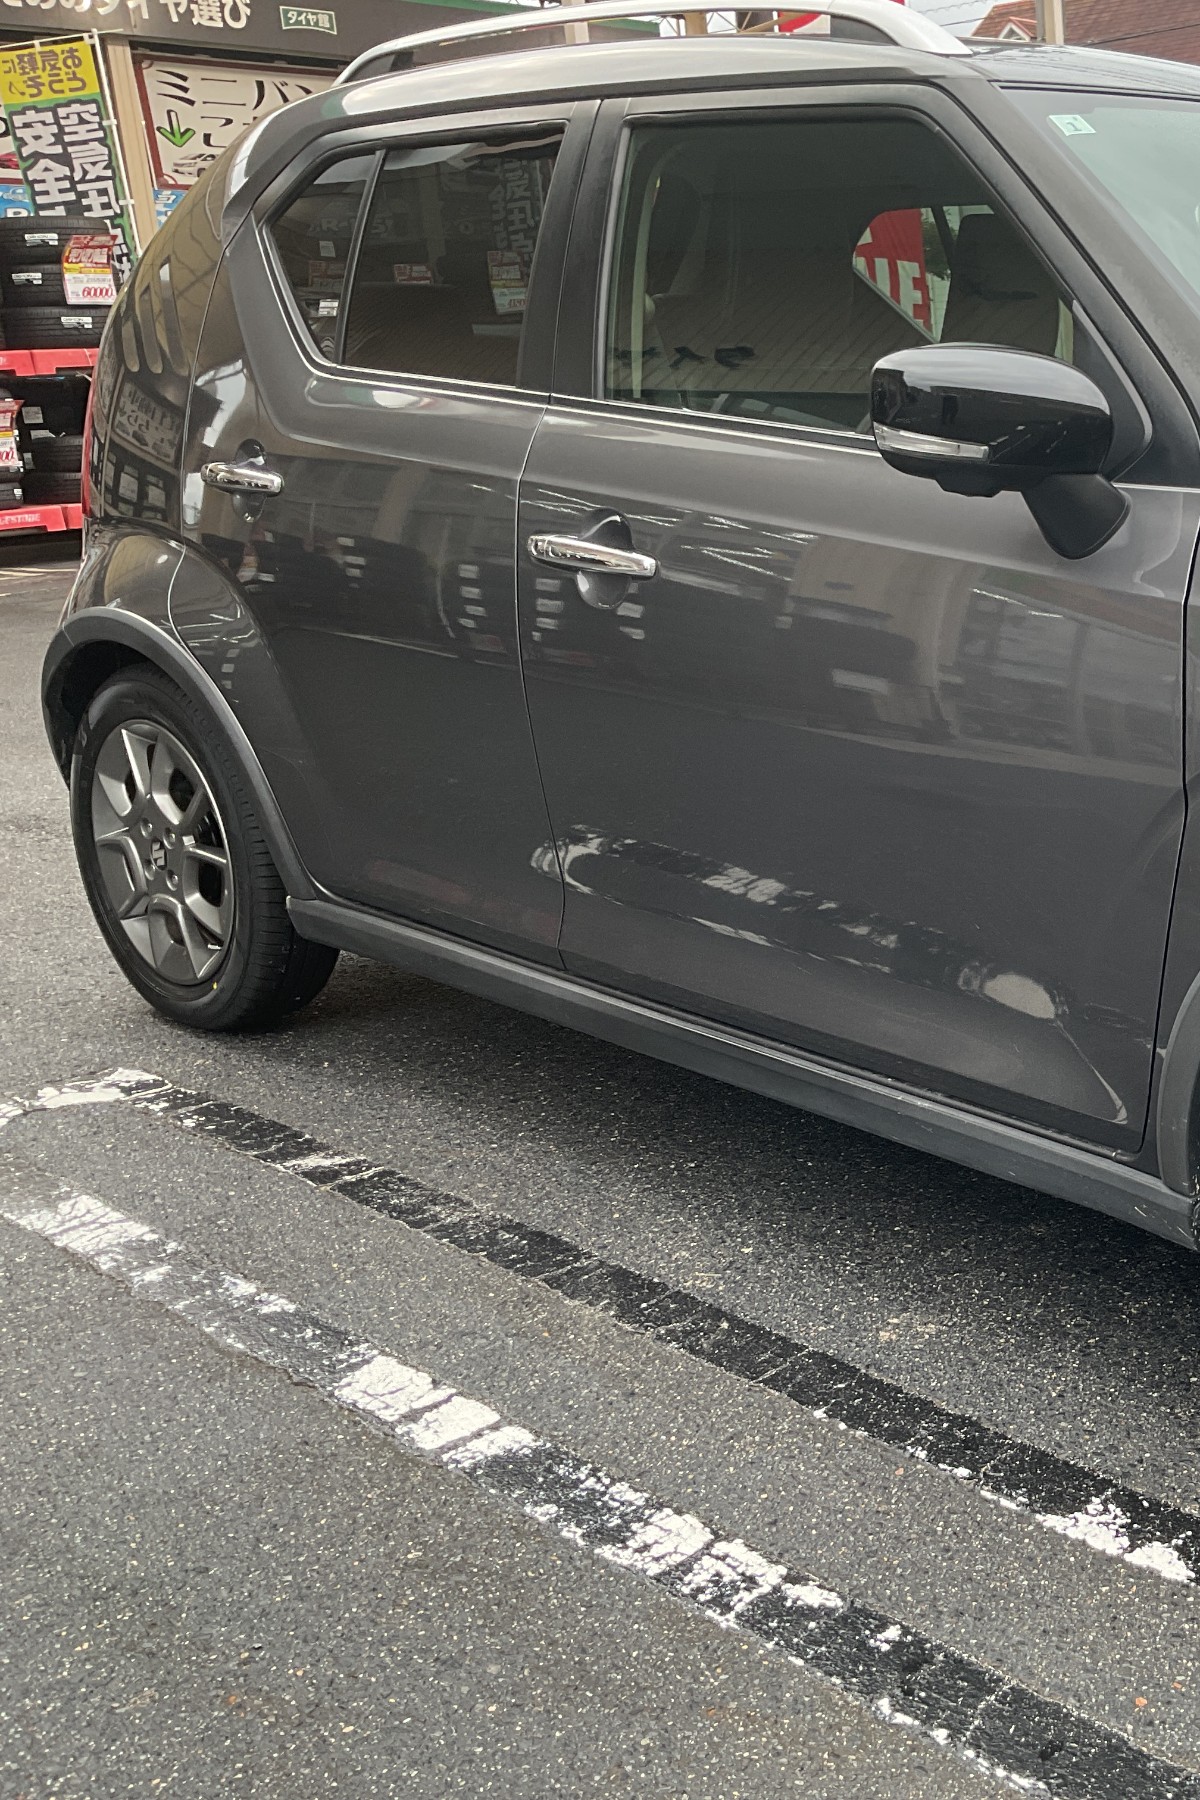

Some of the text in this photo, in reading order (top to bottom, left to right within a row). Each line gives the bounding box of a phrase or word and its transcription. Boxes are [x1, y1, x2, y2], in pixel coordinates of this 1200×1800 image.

[287, 12, 331, 29] タイヤ館
[156, 69, 312, 110] ミニバ
